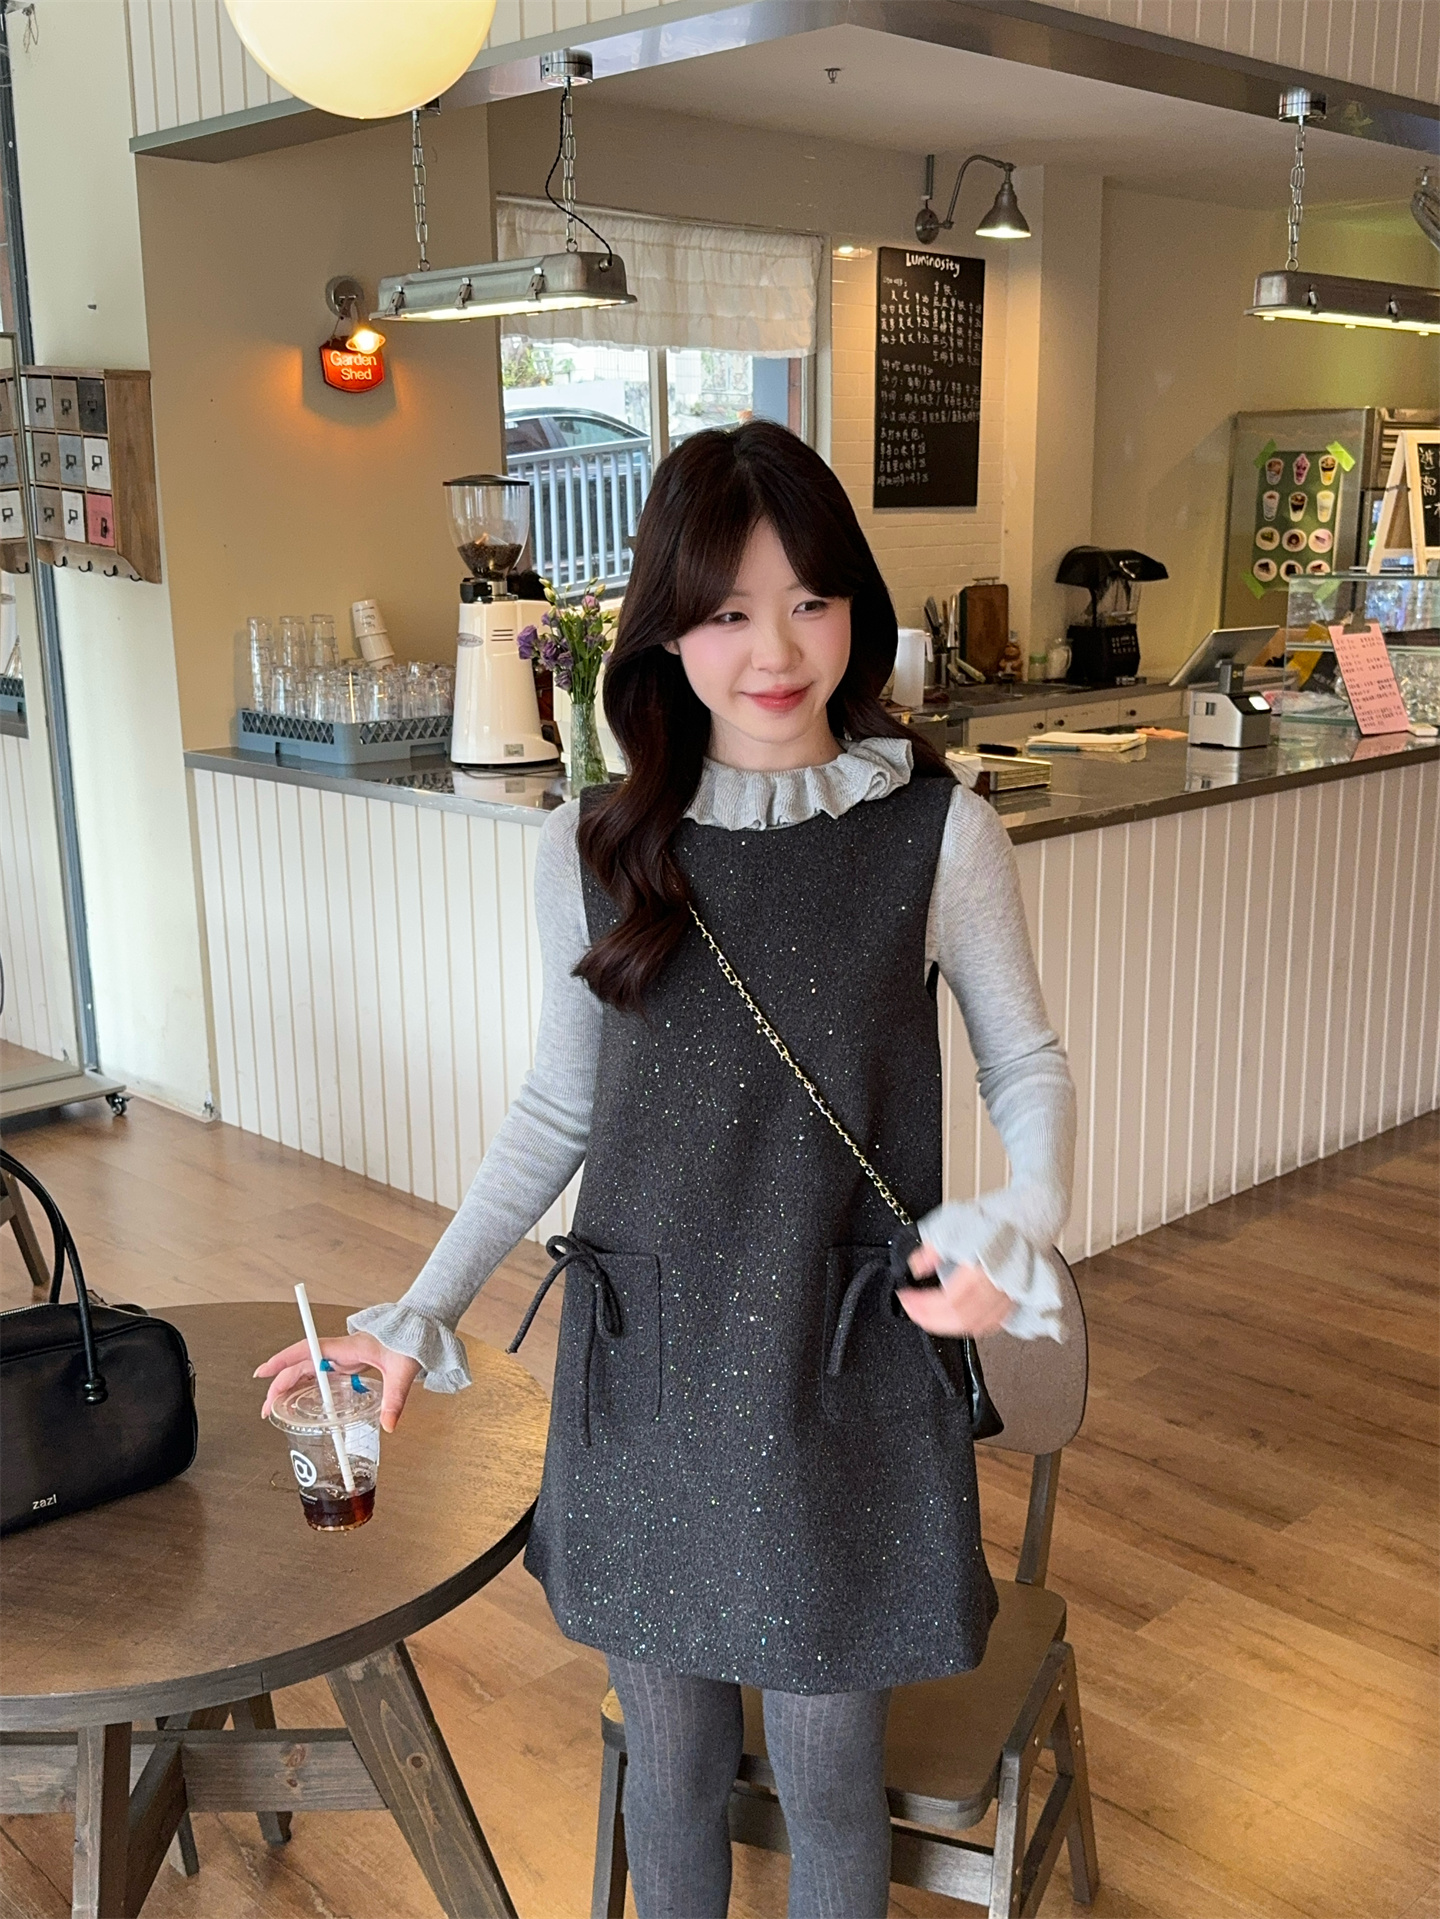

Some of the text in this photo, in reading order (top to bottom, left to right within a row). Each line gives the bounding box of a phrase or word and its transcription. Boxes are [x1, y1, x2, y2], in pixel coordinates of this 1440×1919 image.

[905, 252, 960, 278] Luminosity
[329, 350, 377, 367] Garden
[340, 367, 373, 381] Shed
